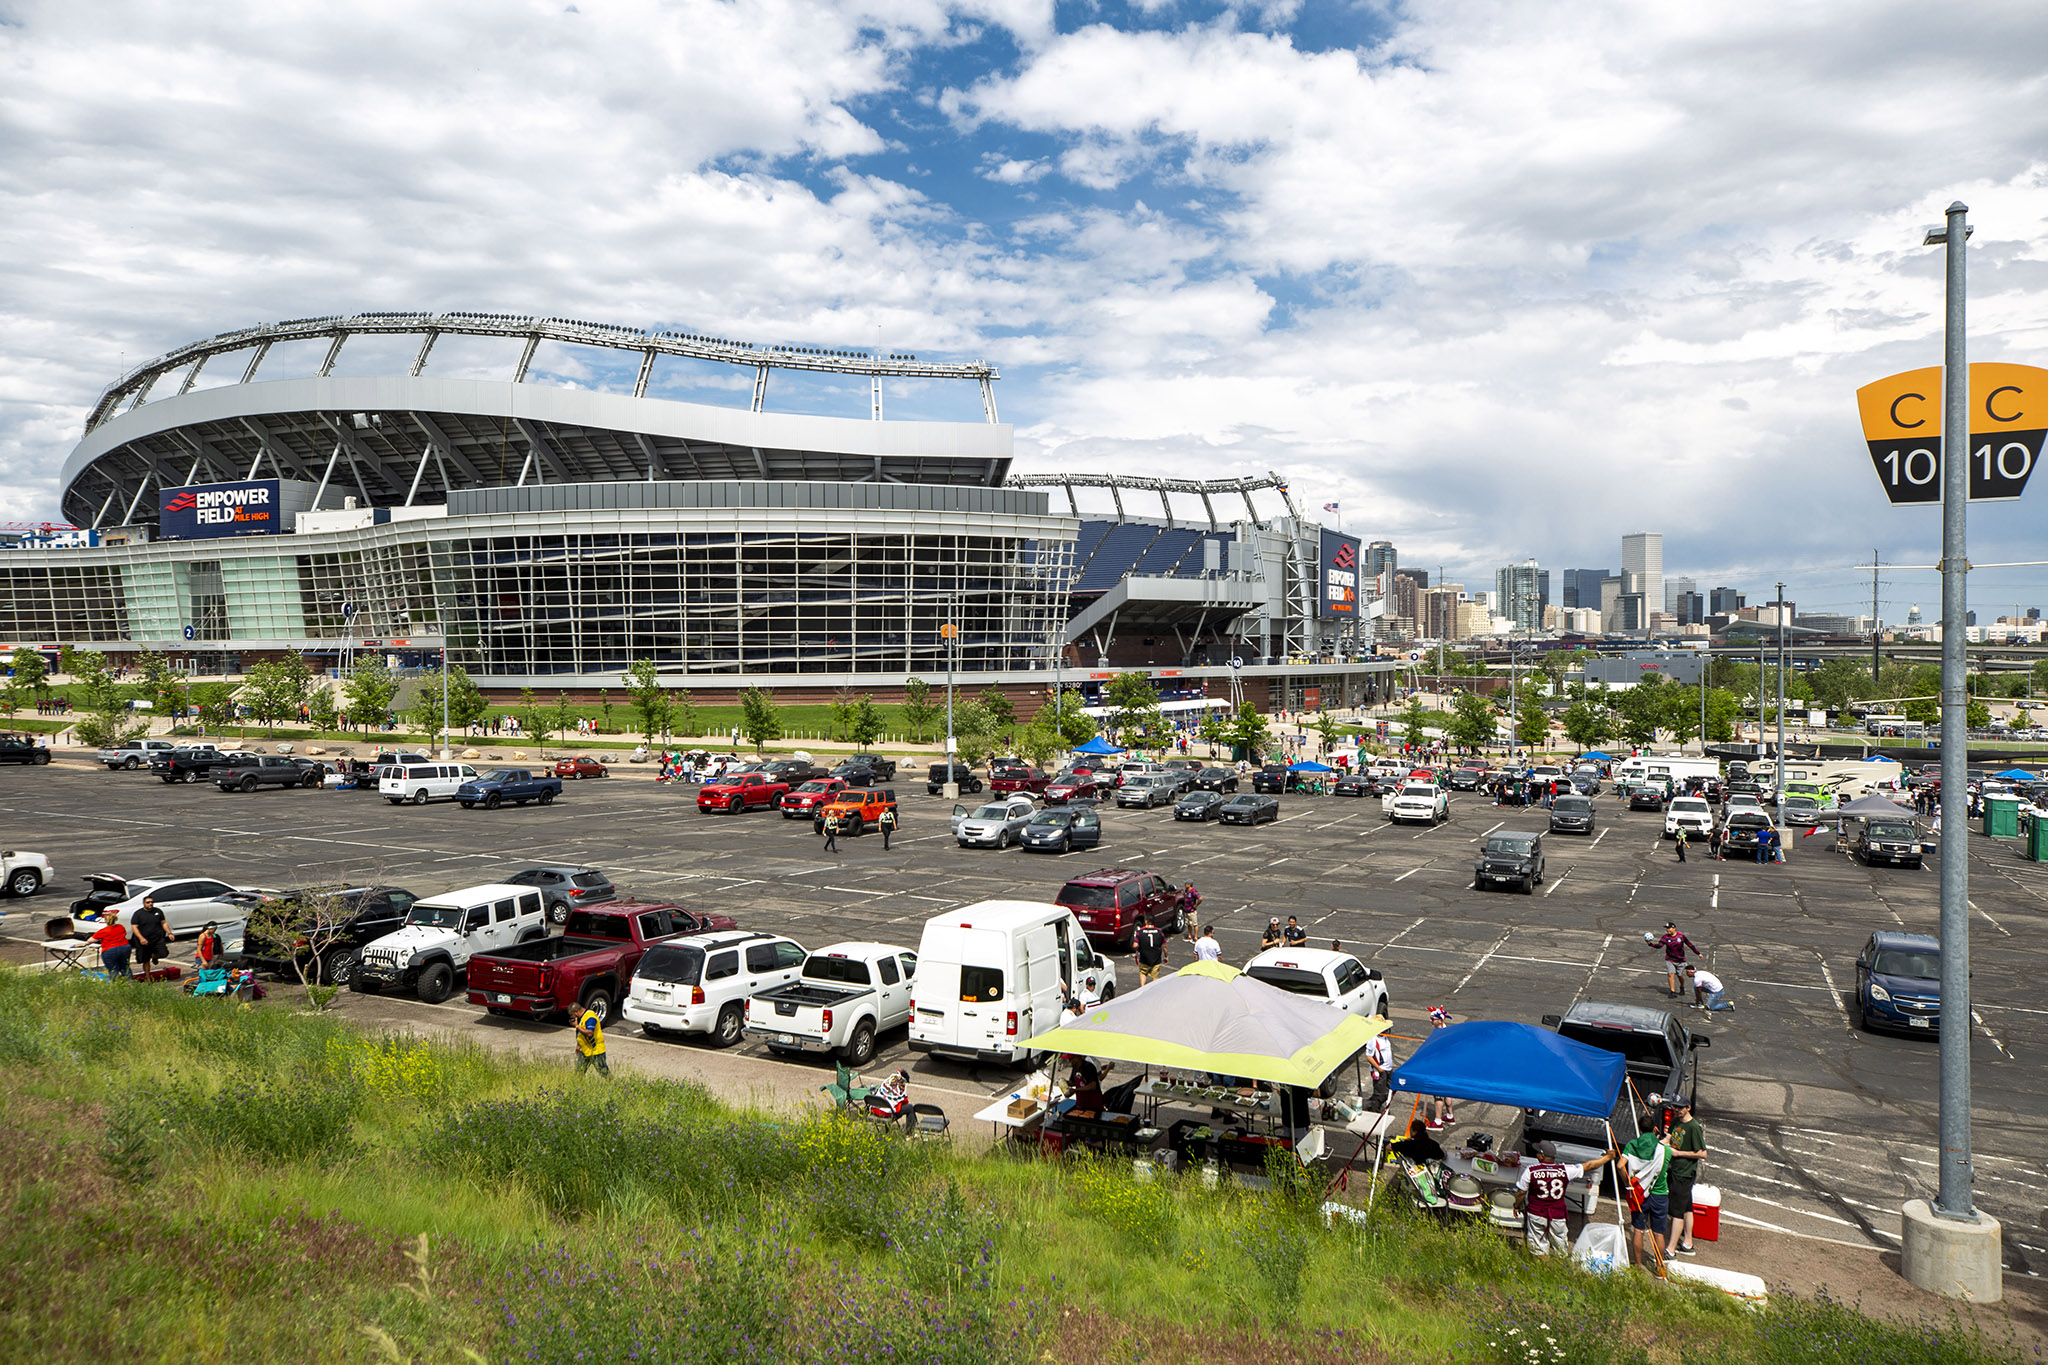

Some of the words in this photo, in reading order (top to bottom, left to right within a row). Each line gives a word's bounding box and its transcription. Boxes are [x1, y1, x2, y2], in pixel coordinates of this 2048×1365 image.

[1890, 392, 1926, 429] C
[1986, 386, 2024, 422] C
[1883, 448, 1936, 486] 10
[1974, 442, 2031, 480] 10
[196, 488, 269, 508] EMPOWER
[197, 507, 235, 524] FIELD
[234, 513, 250, 522] MILE
[252, 512, 269, 520] HIGH
[186, 628, 192, 638] 2
[1234, 660, 1240, 668] 10
[1148, 934, 1154, 948] 1
[1536, 1178, 1564, 1200] 38
